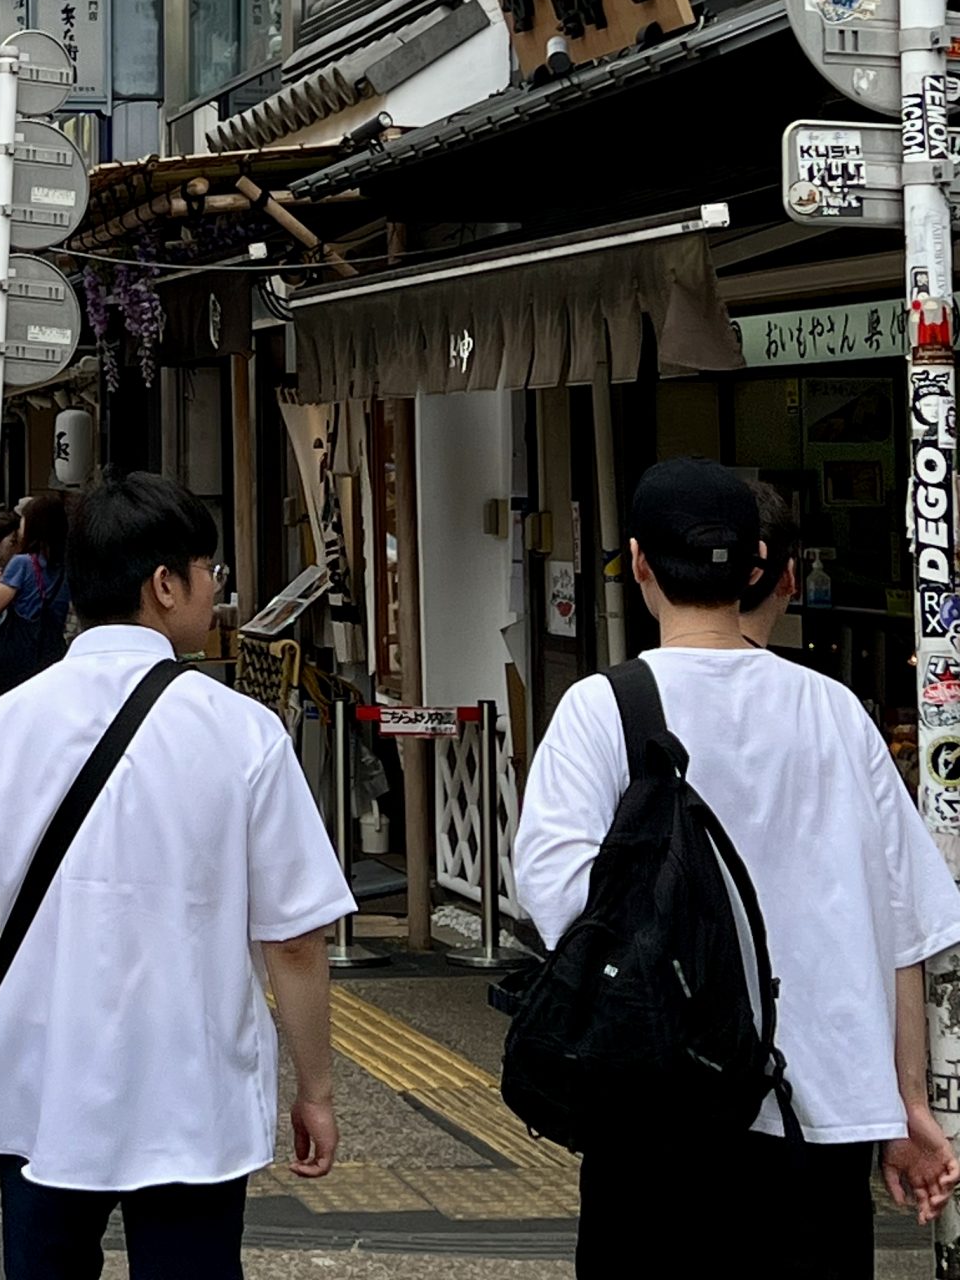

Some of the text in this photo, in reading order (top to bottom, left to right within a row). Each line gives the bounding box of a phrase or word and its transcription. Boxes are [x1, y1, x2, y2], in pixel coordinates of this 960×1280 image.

[800, 145, 860, 159] KUSH
[924, 76, 949, 159] ZEMOK
[916, 446, 950, 585] DEGO
